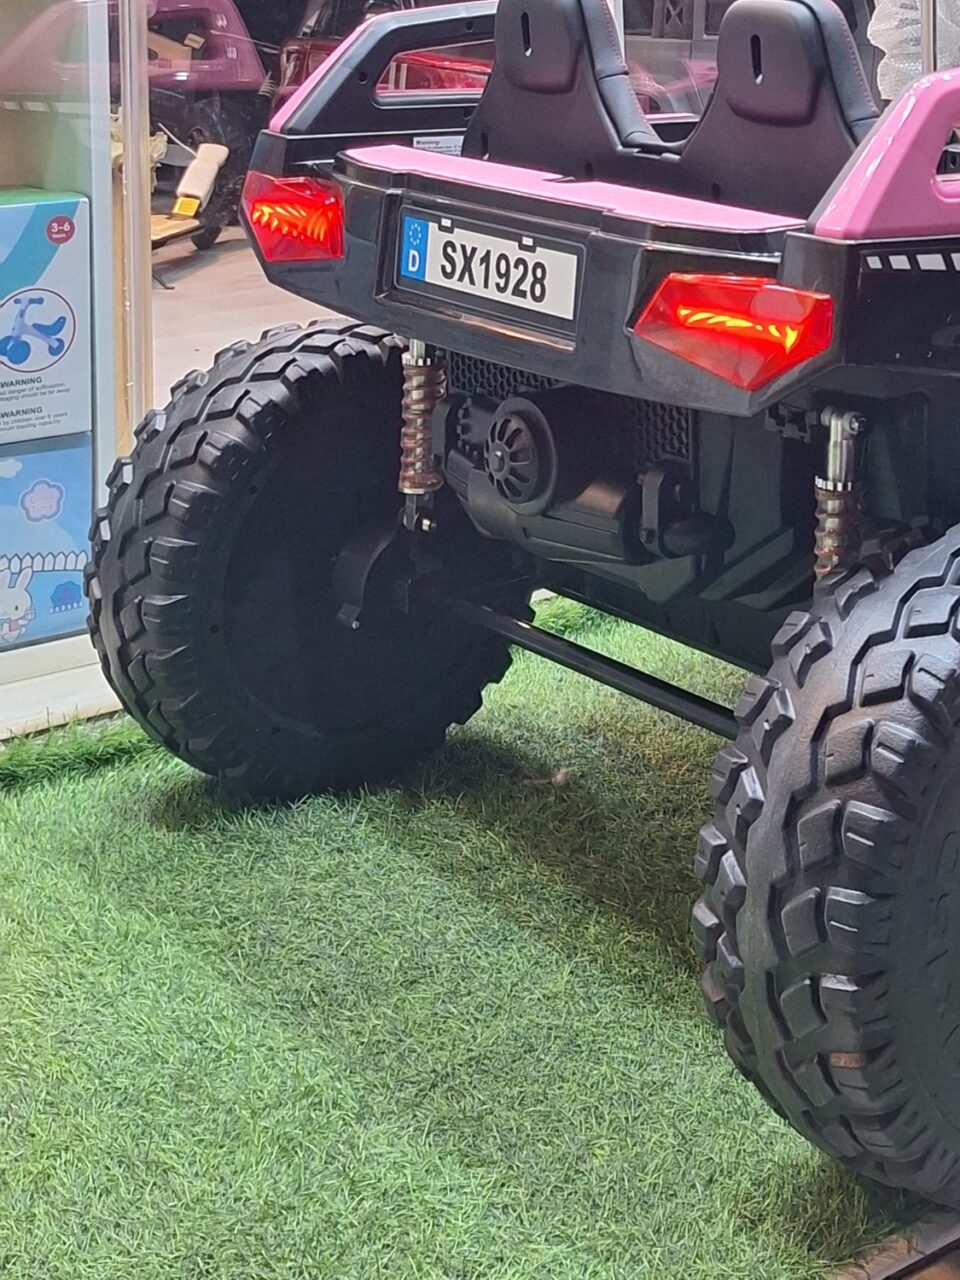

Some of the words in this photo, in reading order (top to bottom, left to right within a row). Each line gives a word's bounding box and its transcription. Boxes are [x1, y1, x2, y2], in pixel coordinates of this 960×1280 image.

[51, 222, 71, 233] 3-6
[408, 249, 420, 272] D
[440, 239, 547, 303] SX1928
[0, 376, 43, 389] WARNING
[1, 406, 43, 419] WARNING
